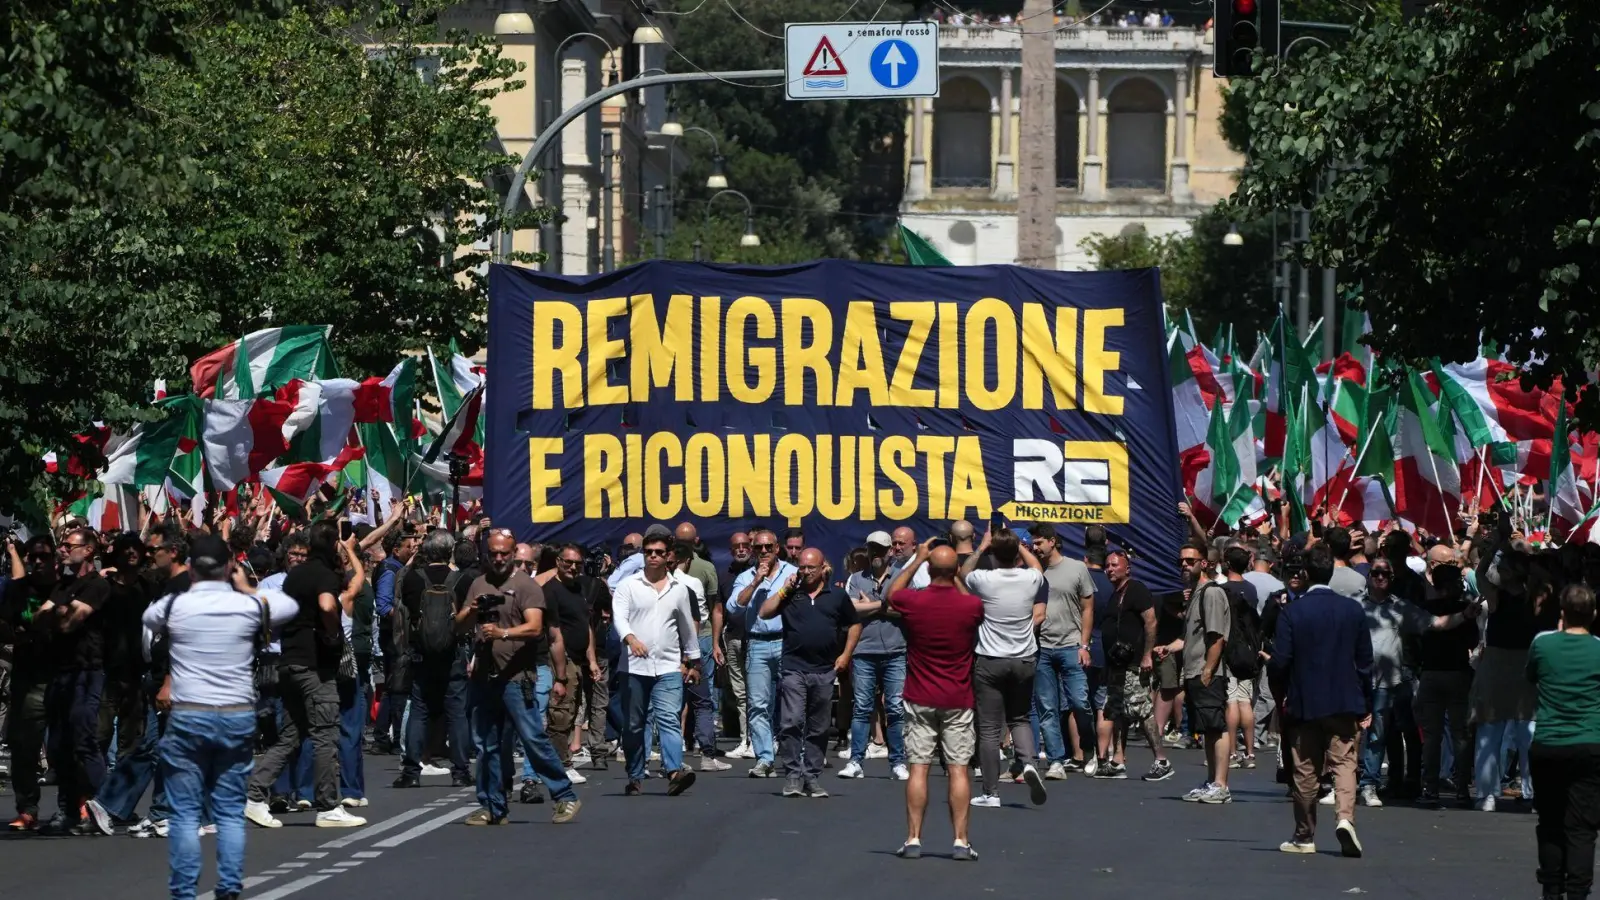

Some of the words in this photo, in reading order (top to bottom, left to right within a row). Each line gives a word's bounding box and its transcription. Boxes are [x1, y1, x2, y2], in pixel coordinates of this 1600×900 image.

[848, 29, 853, 37] a
[857, 27, 902, 37] semaforo
[905, 28, 930, 36] rosso
[532, 293, 1125, 415] REMIGRAZIONE
[529, 437, 564, 523] E
[584, 431, 993, 528] RICONQUISTA
[1013, 438, 1109, 503] RE
[1015, 505, 1103, 520] MIGRAZIONE
